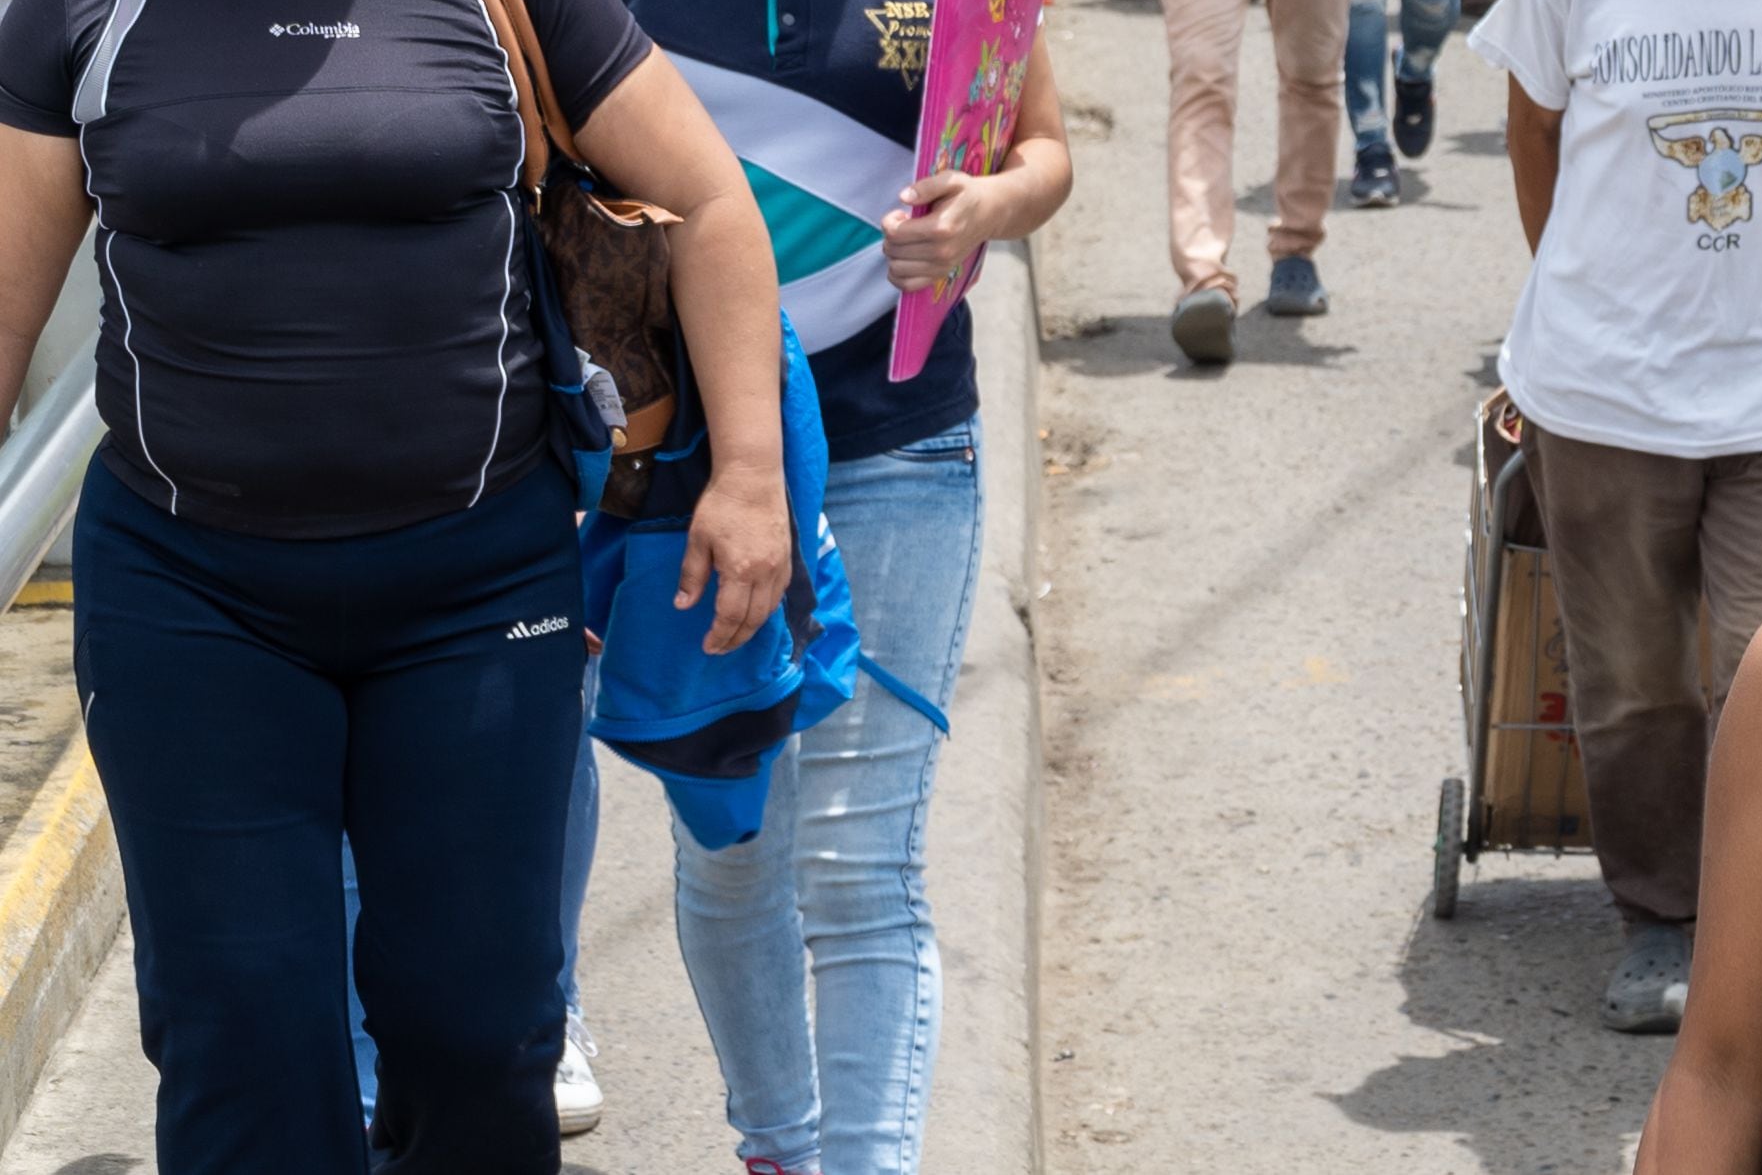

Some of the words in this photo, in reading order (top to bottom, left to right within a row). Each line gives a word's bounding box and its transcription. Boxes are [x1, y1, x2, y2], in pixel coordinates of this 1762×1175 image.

[285, 21, 360, 36] Columbia
[1697, 233, 1741, 252] CCR
[530, 616, 569, 636] adidas
